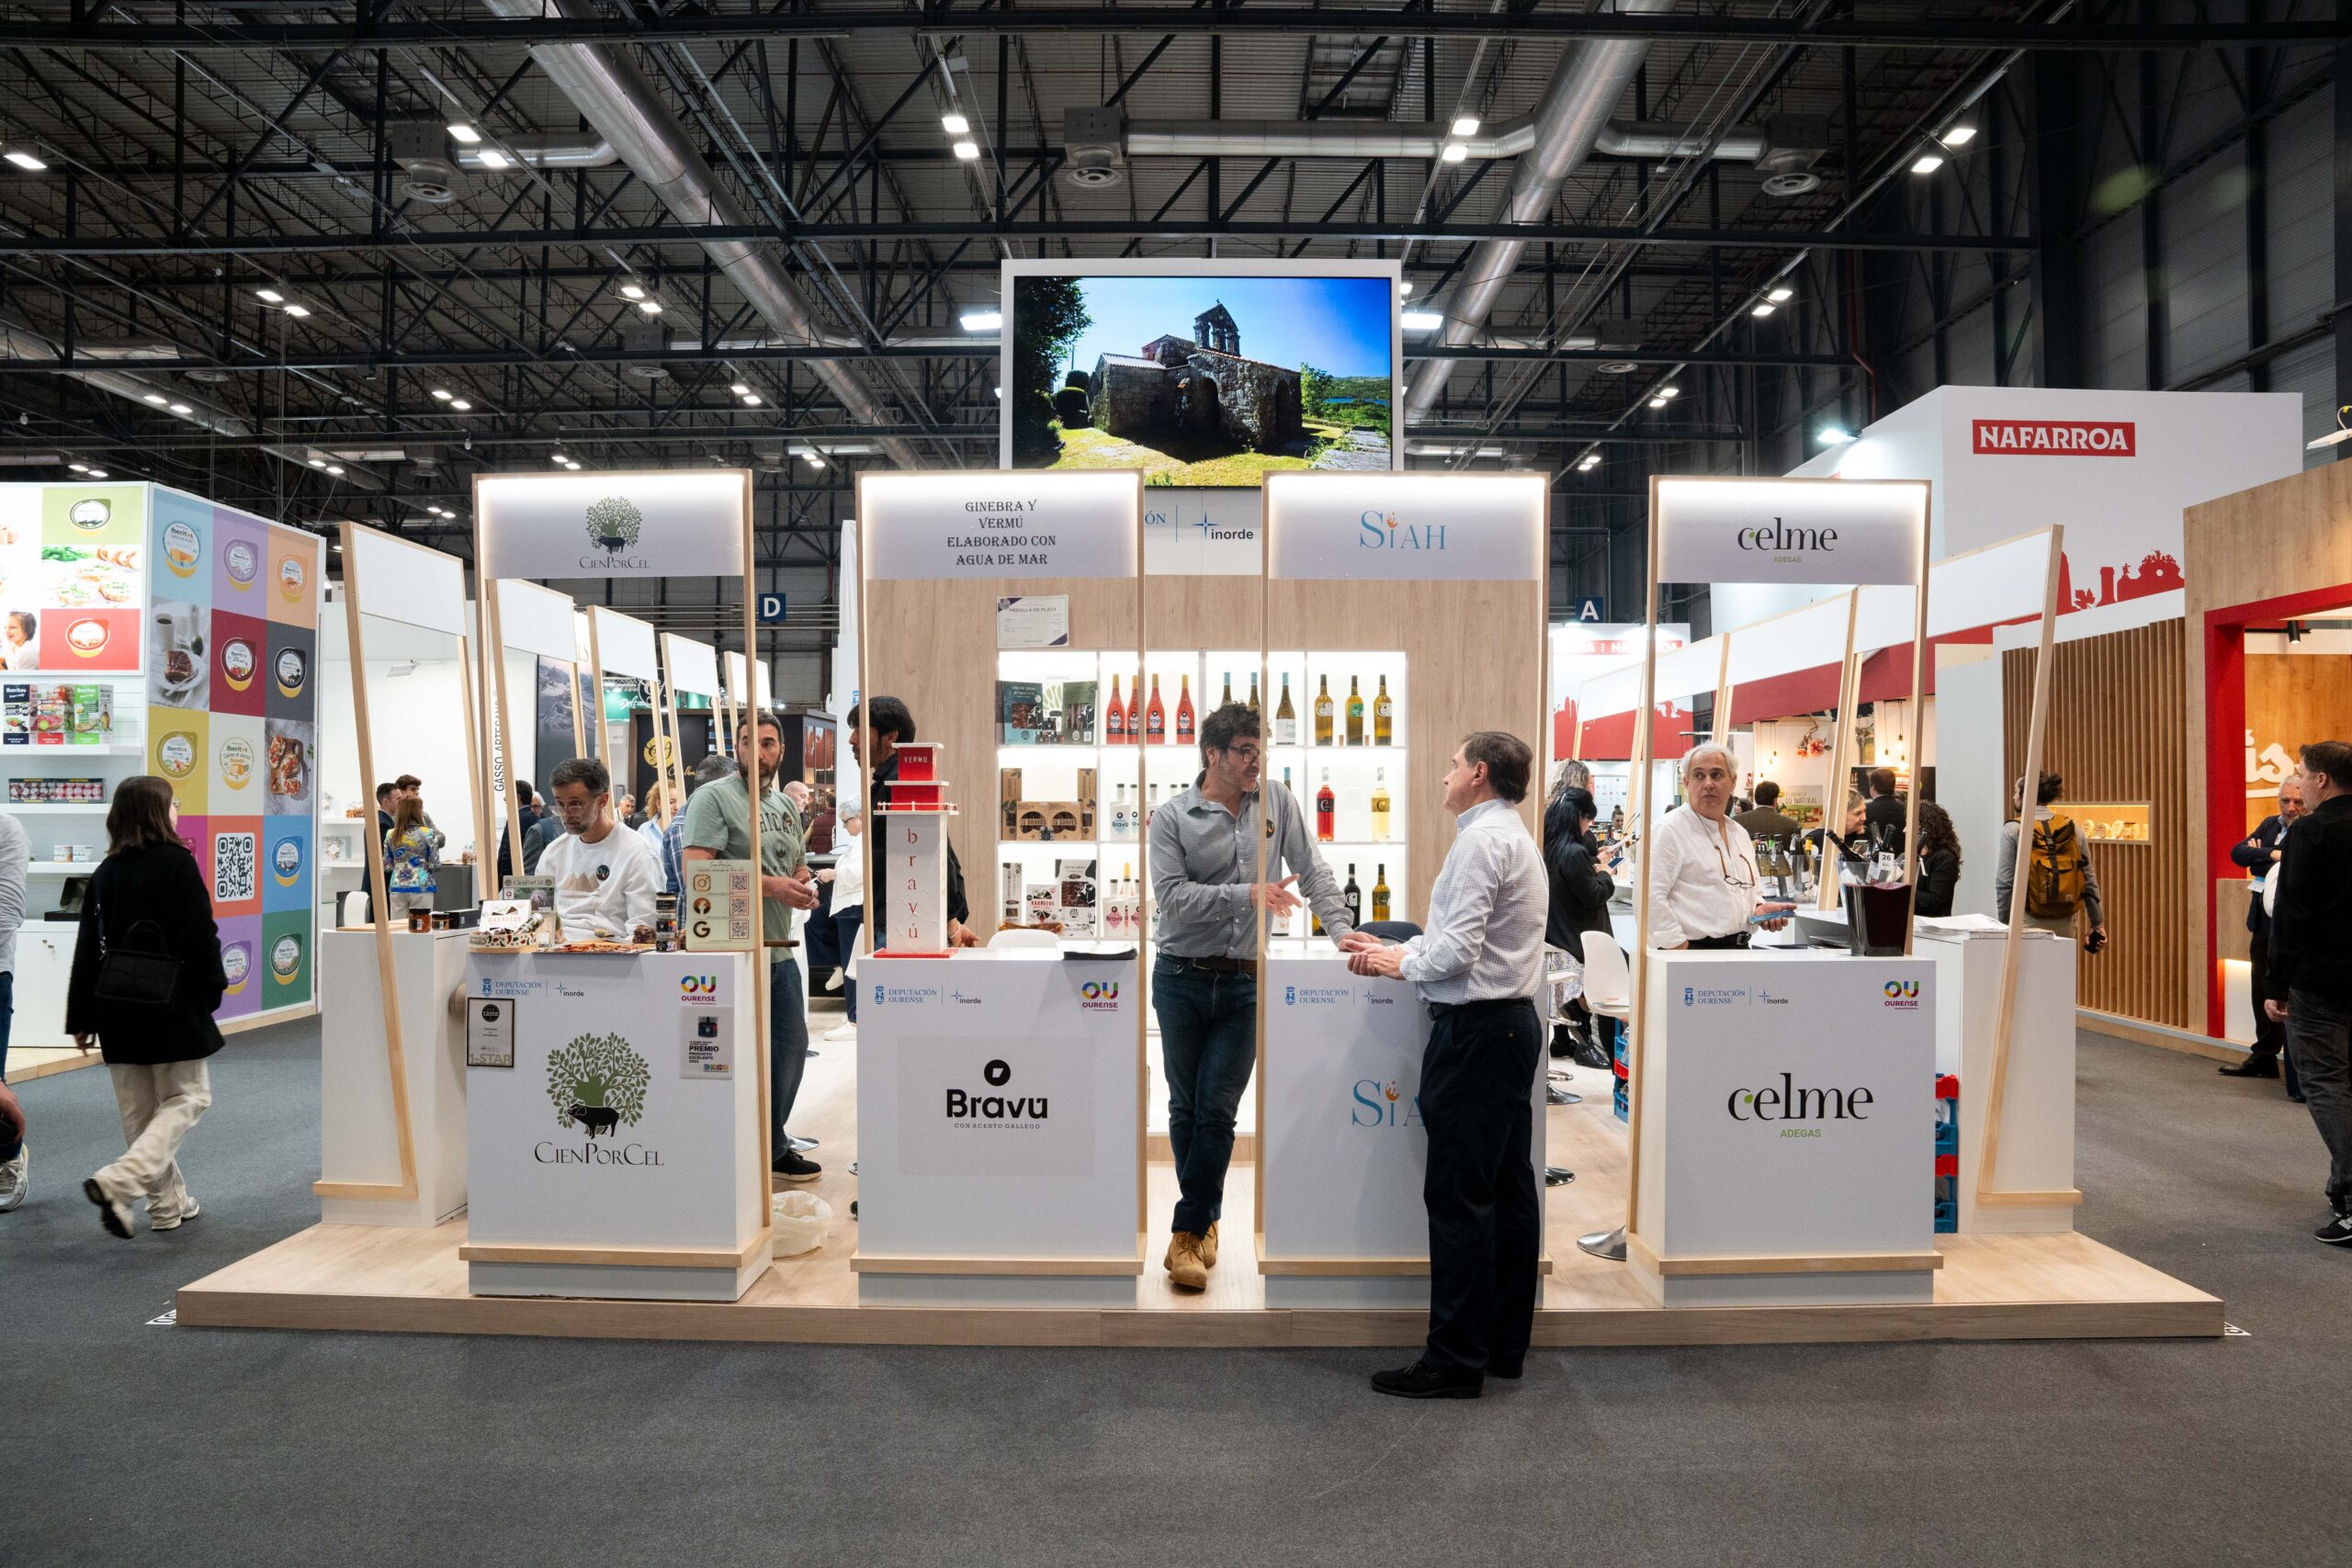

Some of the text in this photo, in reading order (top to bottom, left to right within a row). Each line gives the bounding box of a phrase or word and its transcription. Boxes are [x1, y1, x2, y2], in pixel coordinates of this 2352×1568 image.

[1980, 426, 2128, 450] NAFARROA
[966, 499, 1037, 512] GINEBRA Y
[978, 515, 1023, 528] VERMÚ
[1211, 529, 1253, 539] inorde
[1736, 517, 1838, 551] celme
[947, 536, 1056, 547] ELABORADO CON
[956, 554, 1047, 565] AGUA DE MAR
[763, 597, 781, 617] D
[1579, 600, 1600, 620] A
[495, 980, 542, 989] DEPUTACIÓN
[888, 987, 937, 997] DEPUTACIÓN
[1299, 987, 1349, 997] DEPUTACIÓN
[1698, 988, 1746, 997] DEPUTACIÓN
[469, 1053, 512, 1065] 1-STAR
[1727, 1072, 1873, 1121] celme
[1780, 1129, 1821, 1138] ADEGAS
